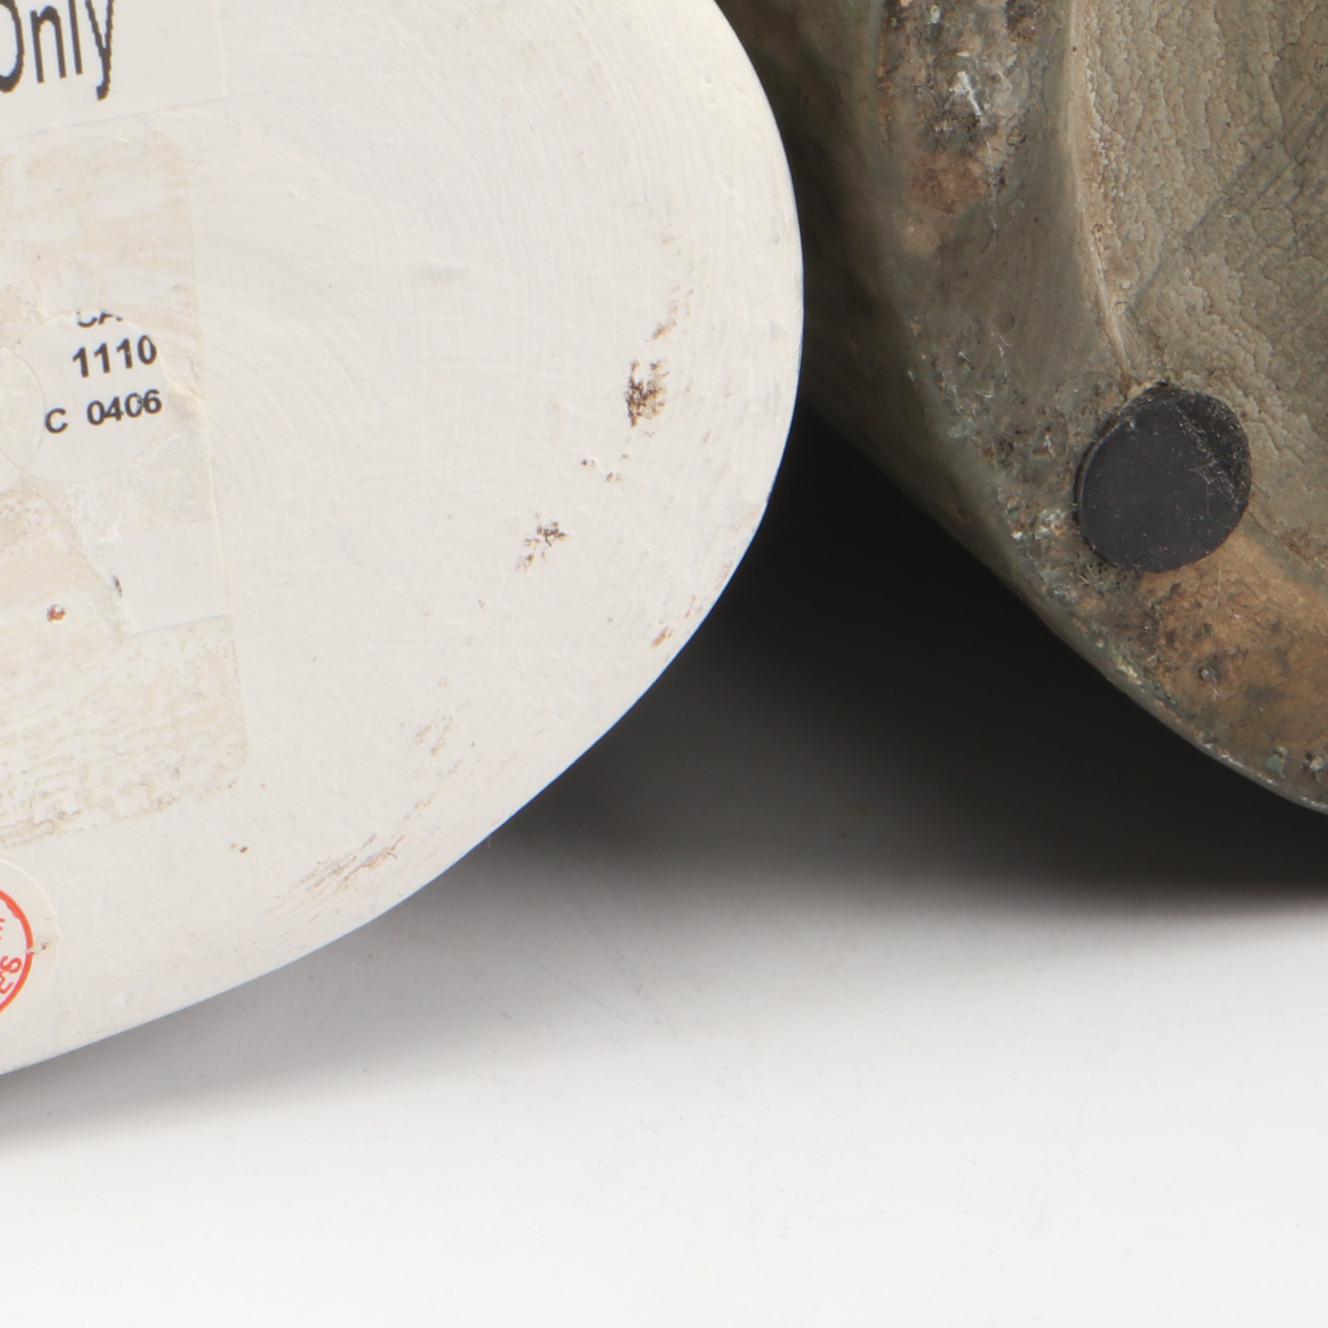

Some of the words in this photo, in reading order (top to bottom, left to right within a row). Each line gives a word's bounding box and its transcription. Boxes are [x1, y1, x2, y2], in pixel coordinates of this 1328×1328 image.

[72, 334, 158, 378] 1110
[44, 407, 69, 434] C
[86, 388, 163, 426] 0406
